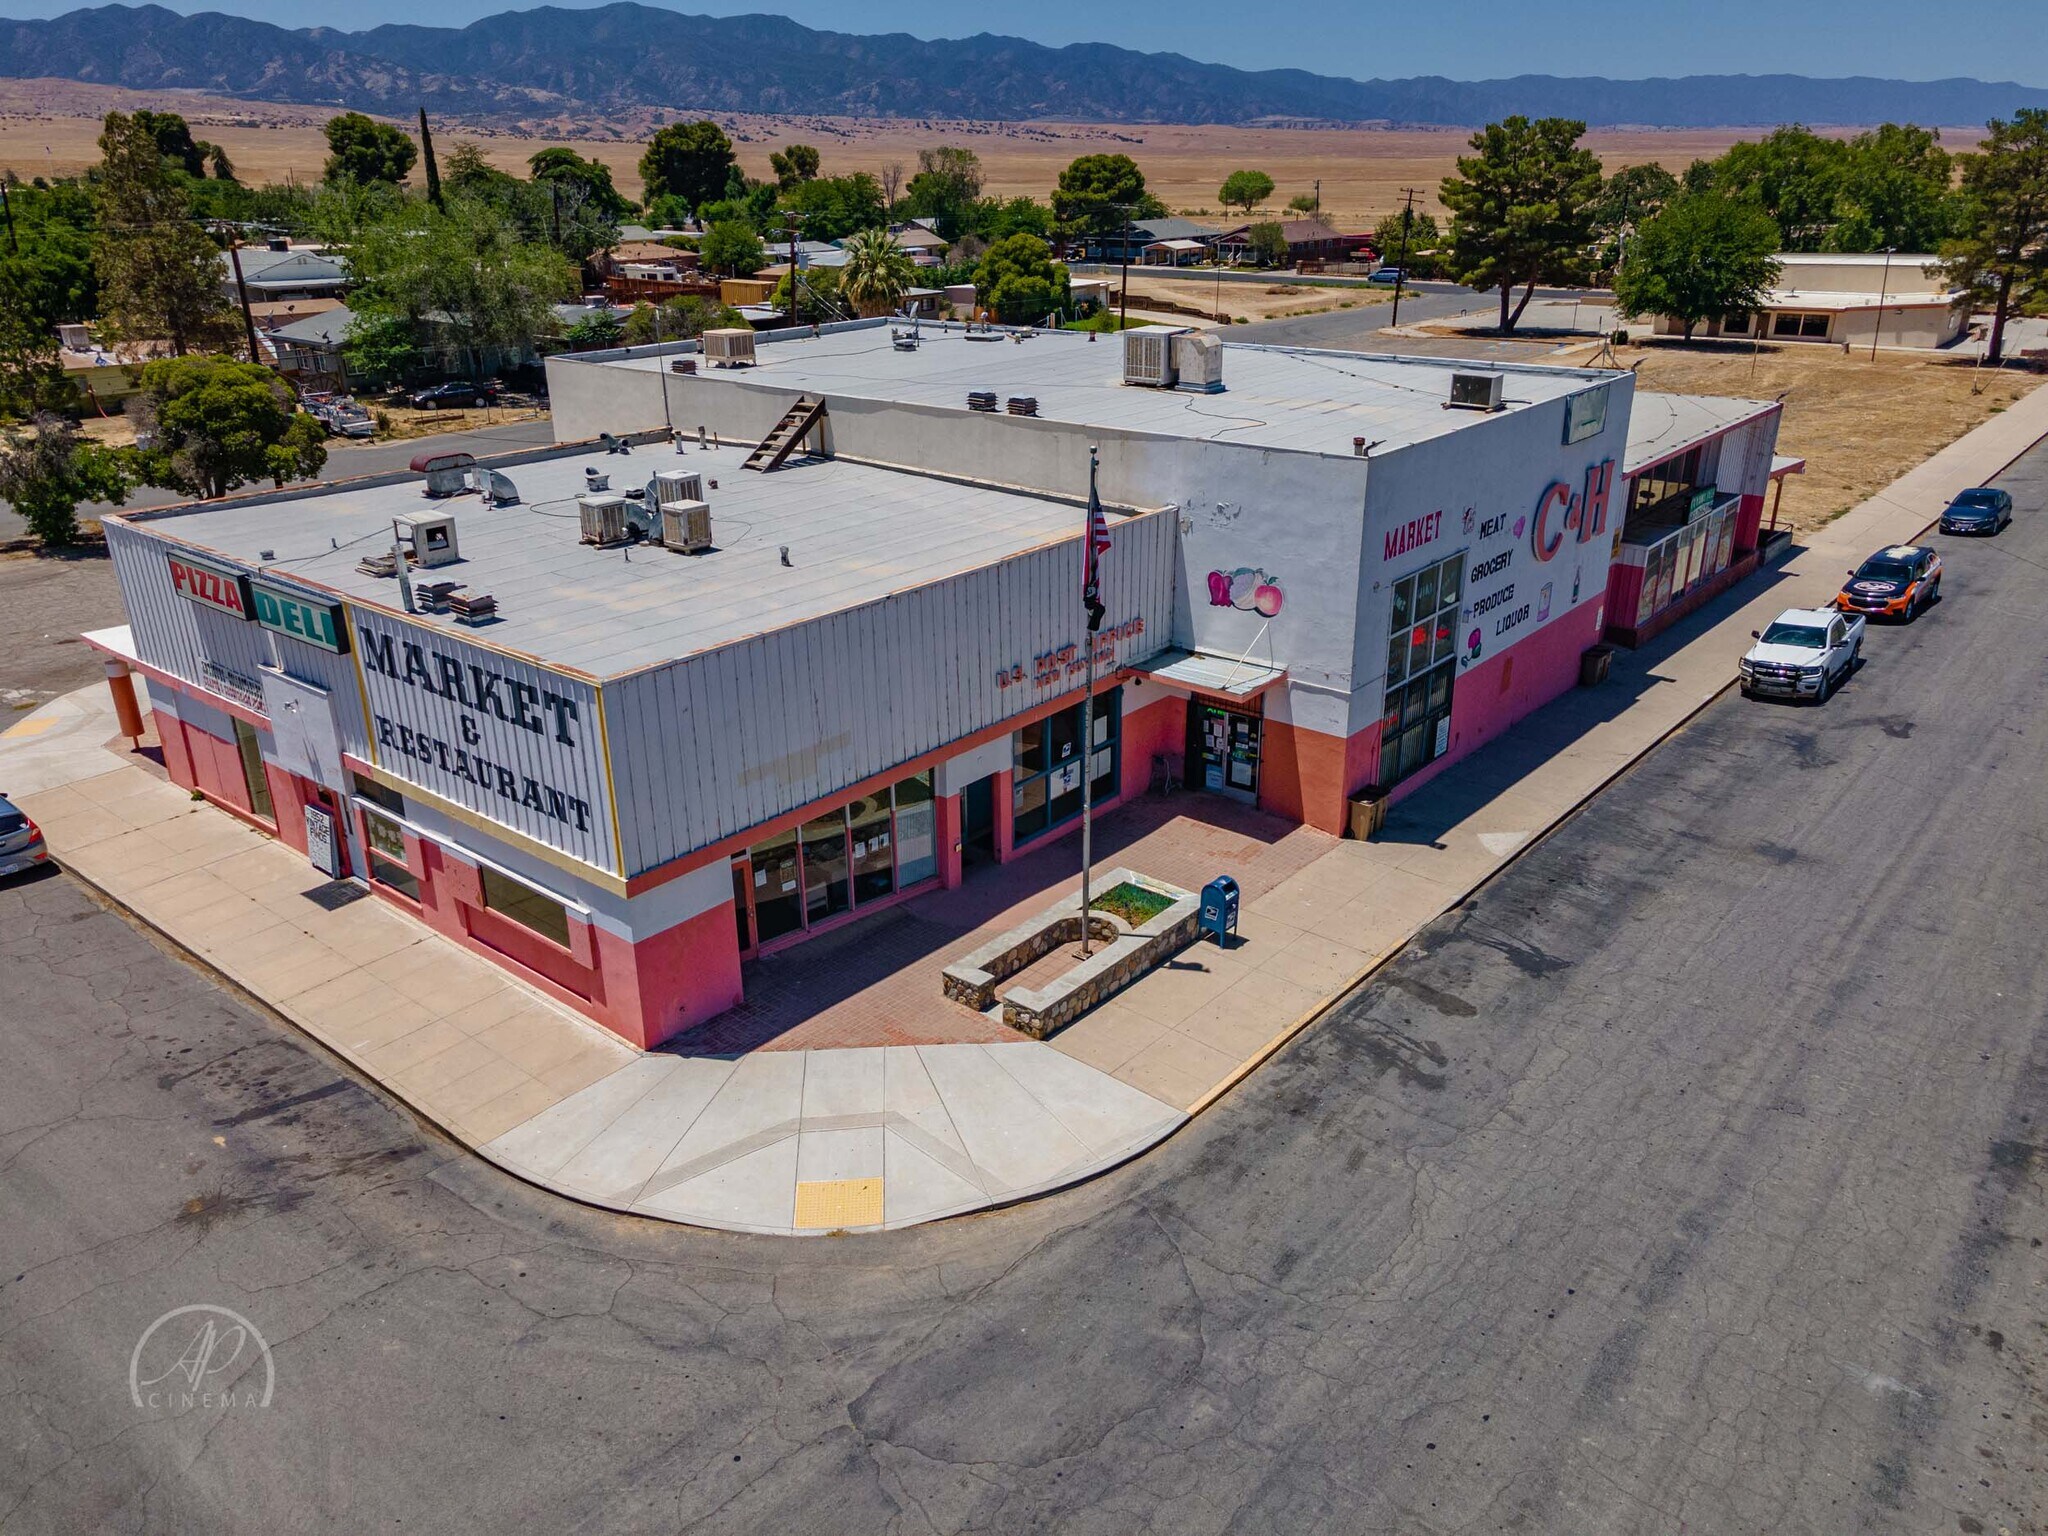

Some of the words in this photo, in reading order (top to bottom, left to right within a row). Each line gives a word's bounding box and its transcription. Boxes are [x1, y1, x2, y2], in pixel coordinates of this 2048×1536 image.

[1384, 510, 1443, 562] MARKET
[1479, 513, 1507, 540] MEAT
[1471, 549, 1514, 583] GROCERY
[169, 560, 244, 613] PIZZA
[1473, 584, 1515, 618] PRODUCE
[254, 590, 339, 647] DELI
[1495, 604, 1530, 636] LIQUOR
[1035, 644, 1077, 673] POST
[360, 625, 579, 748] MARKET
[1035, 670, 1060, 688] NEW
[460, 713, 482, 746] &
[375, 714, 591, 833] RESTAURANT
